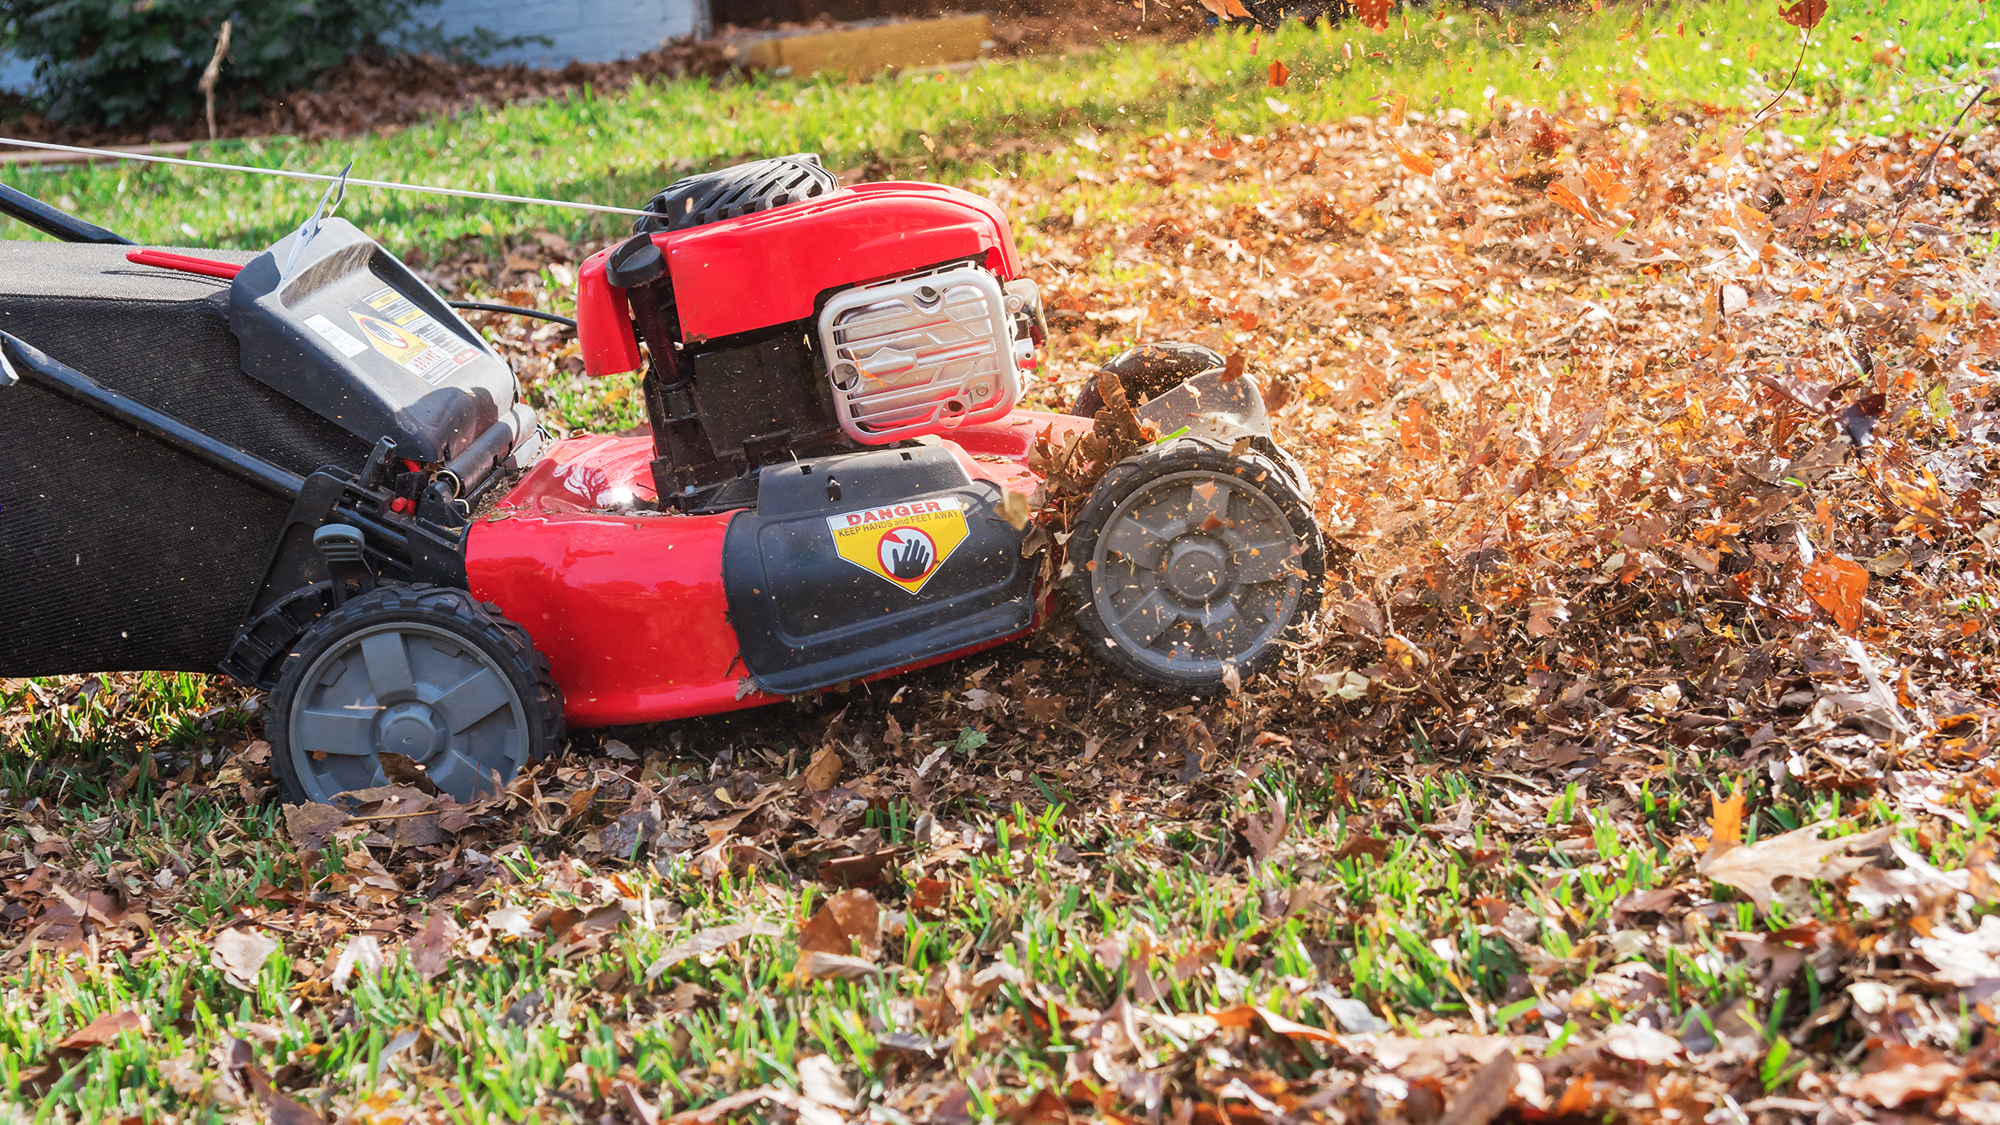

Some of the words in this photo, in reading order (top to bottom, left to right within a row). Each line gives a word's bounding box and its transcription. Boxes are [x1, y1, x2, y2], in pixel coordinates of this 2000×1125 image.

[838, 527, 861, 537] KEEP
[863, 520, 893, 533] HANDS
[894, 518, 910, 526] and
[911, 514, 932, 523] FEET
[934, 510, 959, 520] AWAY
[846, 502, 941, 526] DANGER
